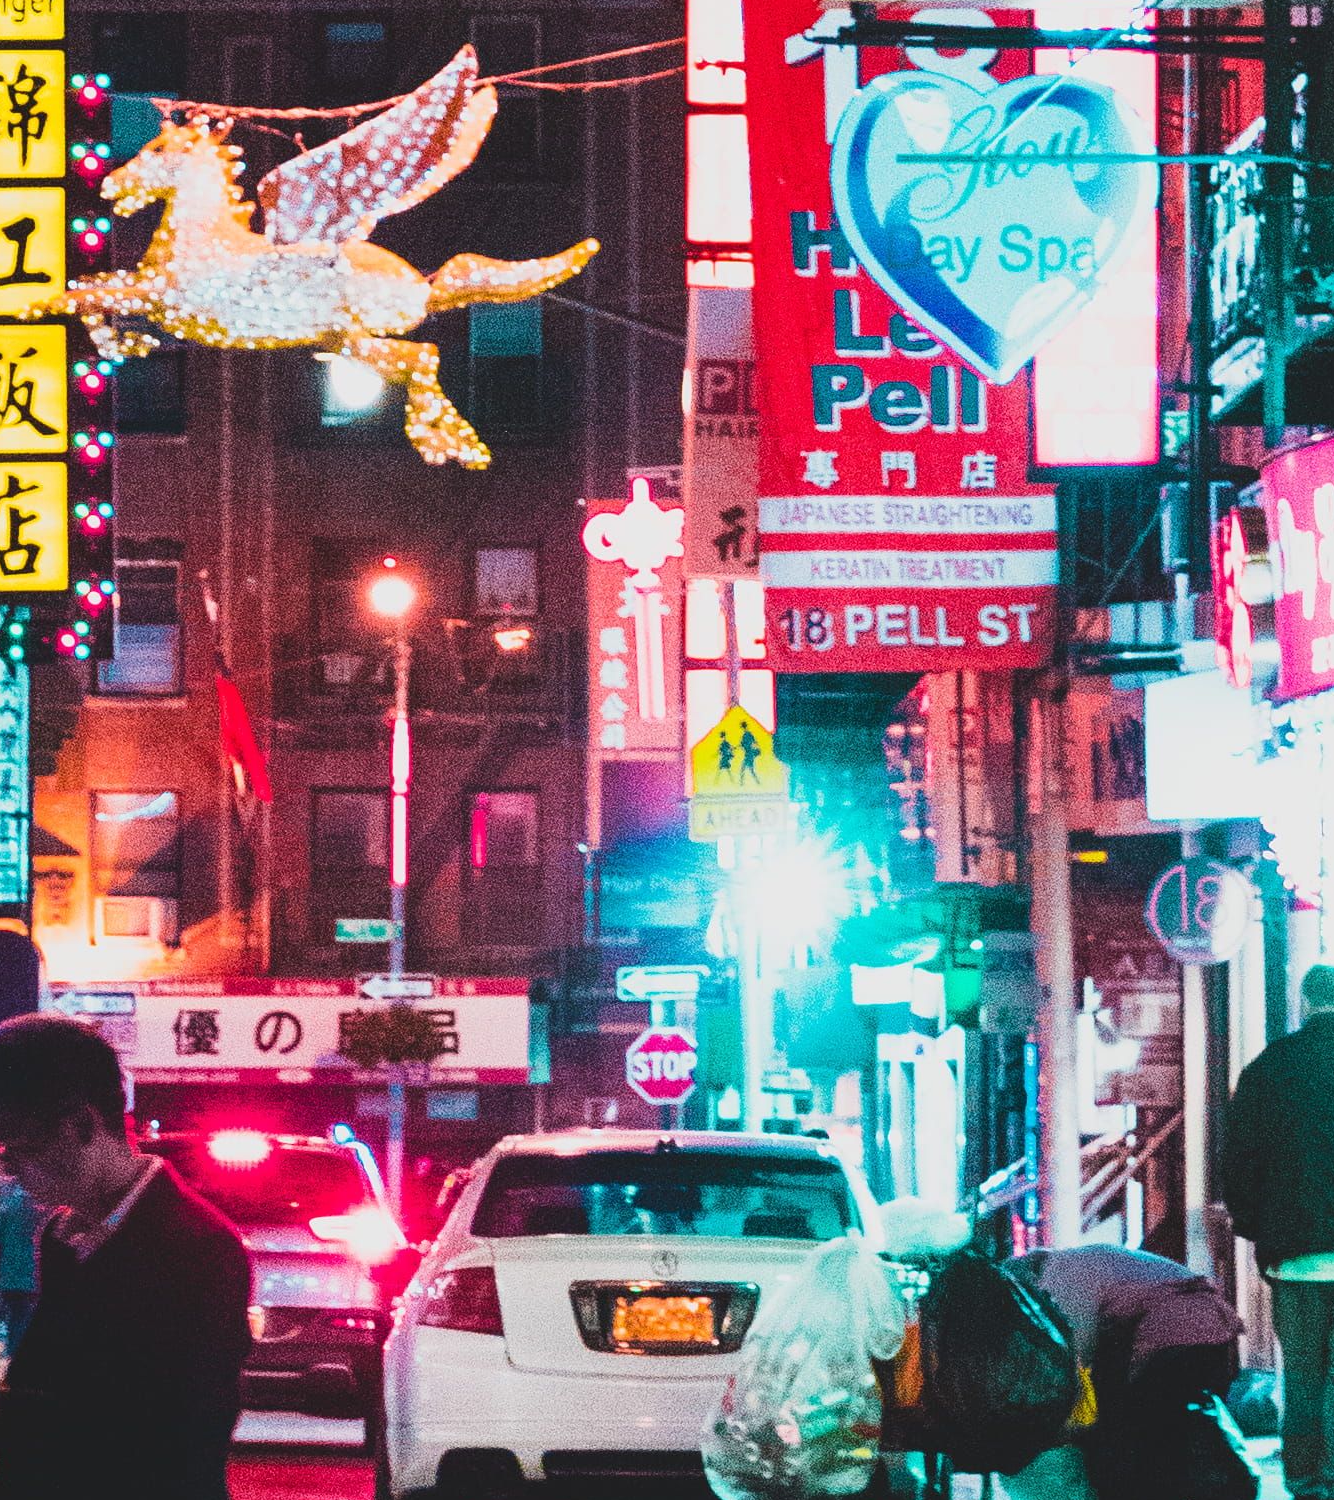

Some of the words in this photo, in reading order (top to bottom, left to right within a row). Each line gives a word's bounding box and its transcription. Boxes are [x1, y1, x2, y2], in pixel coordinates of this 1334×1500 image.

[811, 364, 989, 434] Pell
[777, 500, 879, 528] JAPANESE
[881, 500, 1035, 528] STRAIGHTENING
[809, 556, 893, 584] KERATIN
[897, 556, 1007, 584] TREATMENT
[843, 604, 965, 648] PELL
[977, 604, 1039, 646] ST
[632, 1052, 697, 1082] STOP
